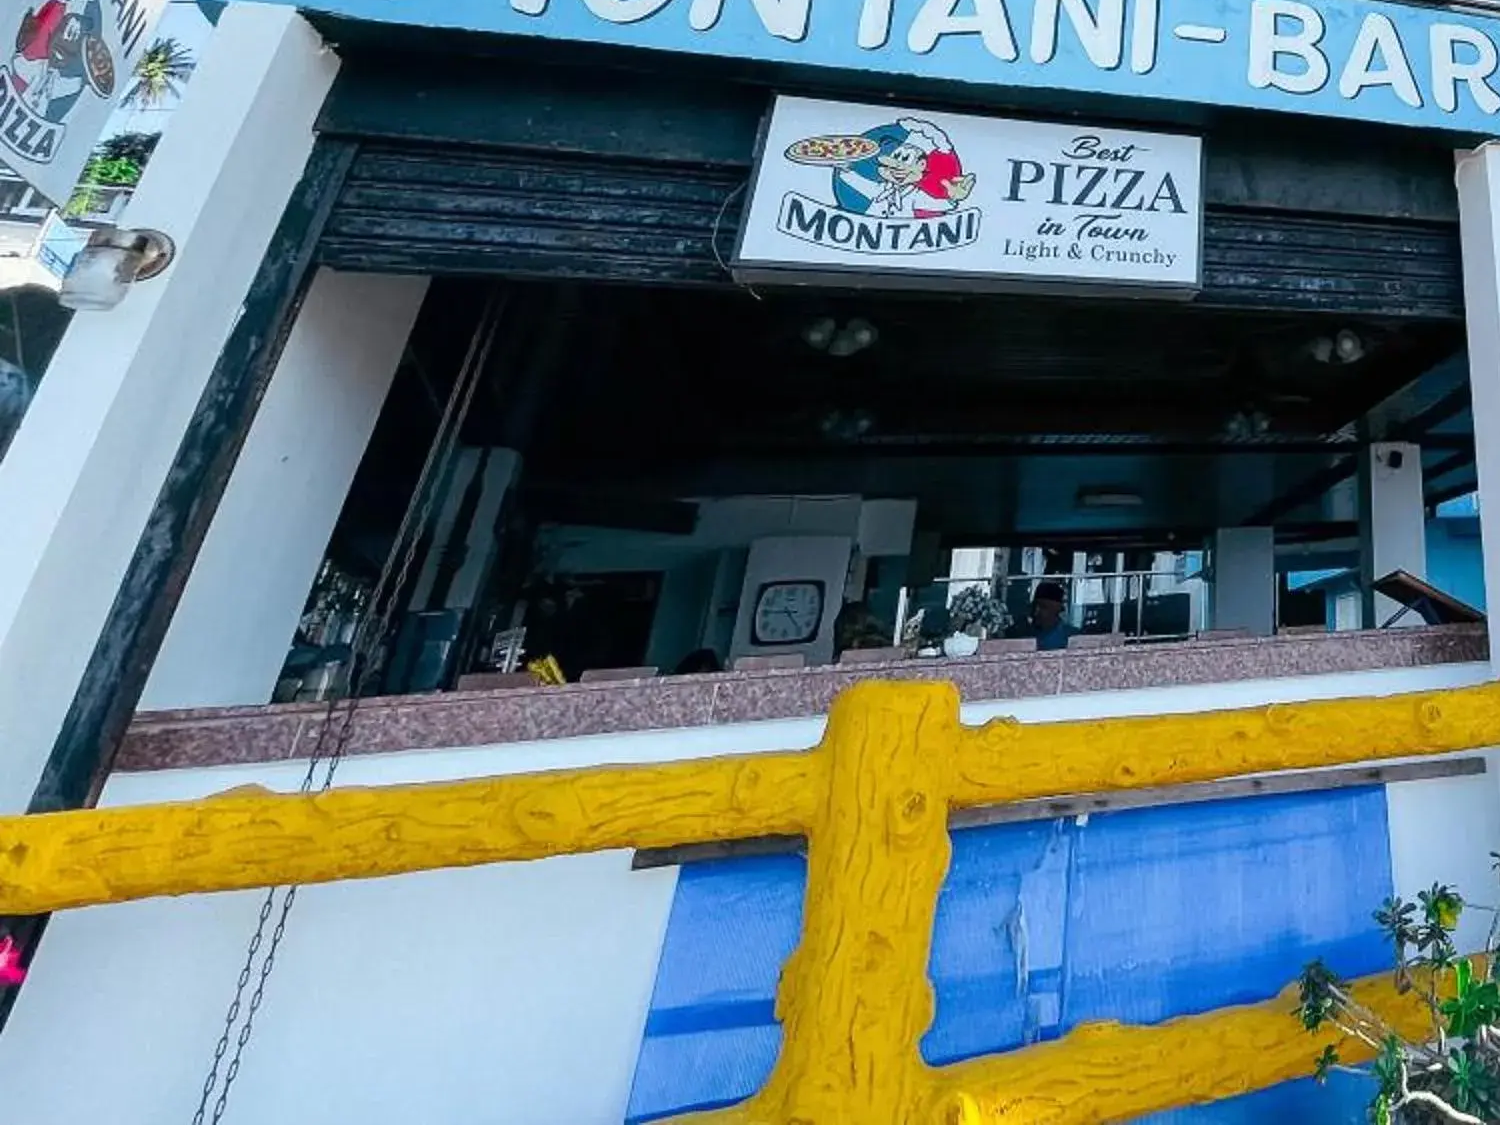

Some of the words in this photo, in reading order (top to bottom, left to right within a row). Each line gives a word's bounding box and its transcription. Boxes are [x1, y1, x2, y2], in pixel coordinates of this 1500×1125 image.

[1062, 135, 1152, 163] Best
[1002, 158, 1188, 214] PIZZA
[785, 198, 977, 251] MONTANI
[1037, 216, 1065, 236] in
[1074, 213, 1149, 242] Town
[1003, 238, 1060, 261] Light
[1066, 244, 1083, 261] &
[1090, 245, 1177, 267] Crunchy
